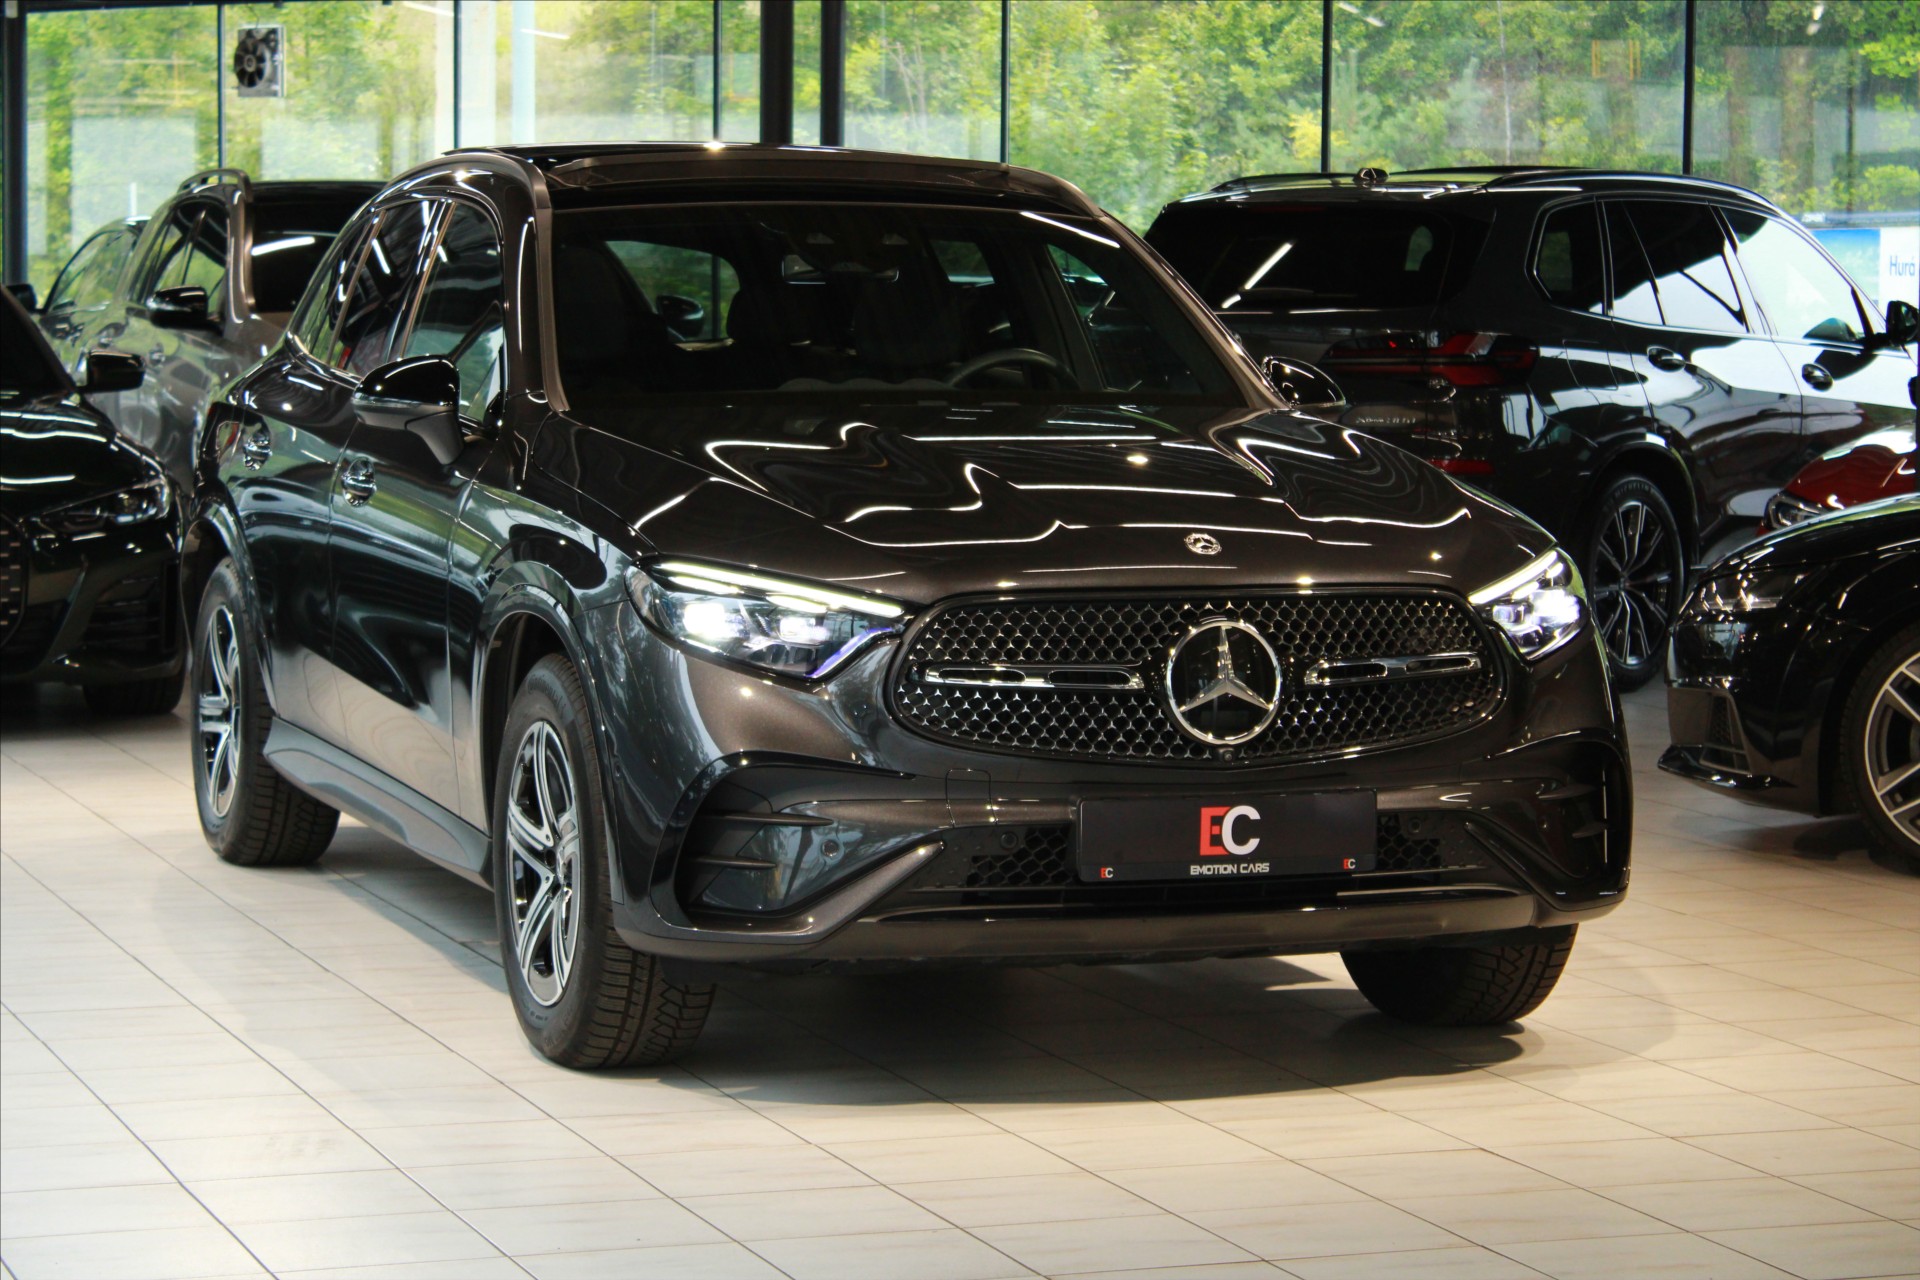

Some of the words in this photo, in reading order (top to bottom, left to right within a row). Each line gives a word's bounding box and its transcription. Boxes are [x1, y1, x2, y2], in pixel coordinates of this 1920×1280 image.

[1200, 805, 1261, 856] EC
[1190, 864, 1237, 875] EMOTION
[1240, 863, 1269, 873] CARS
